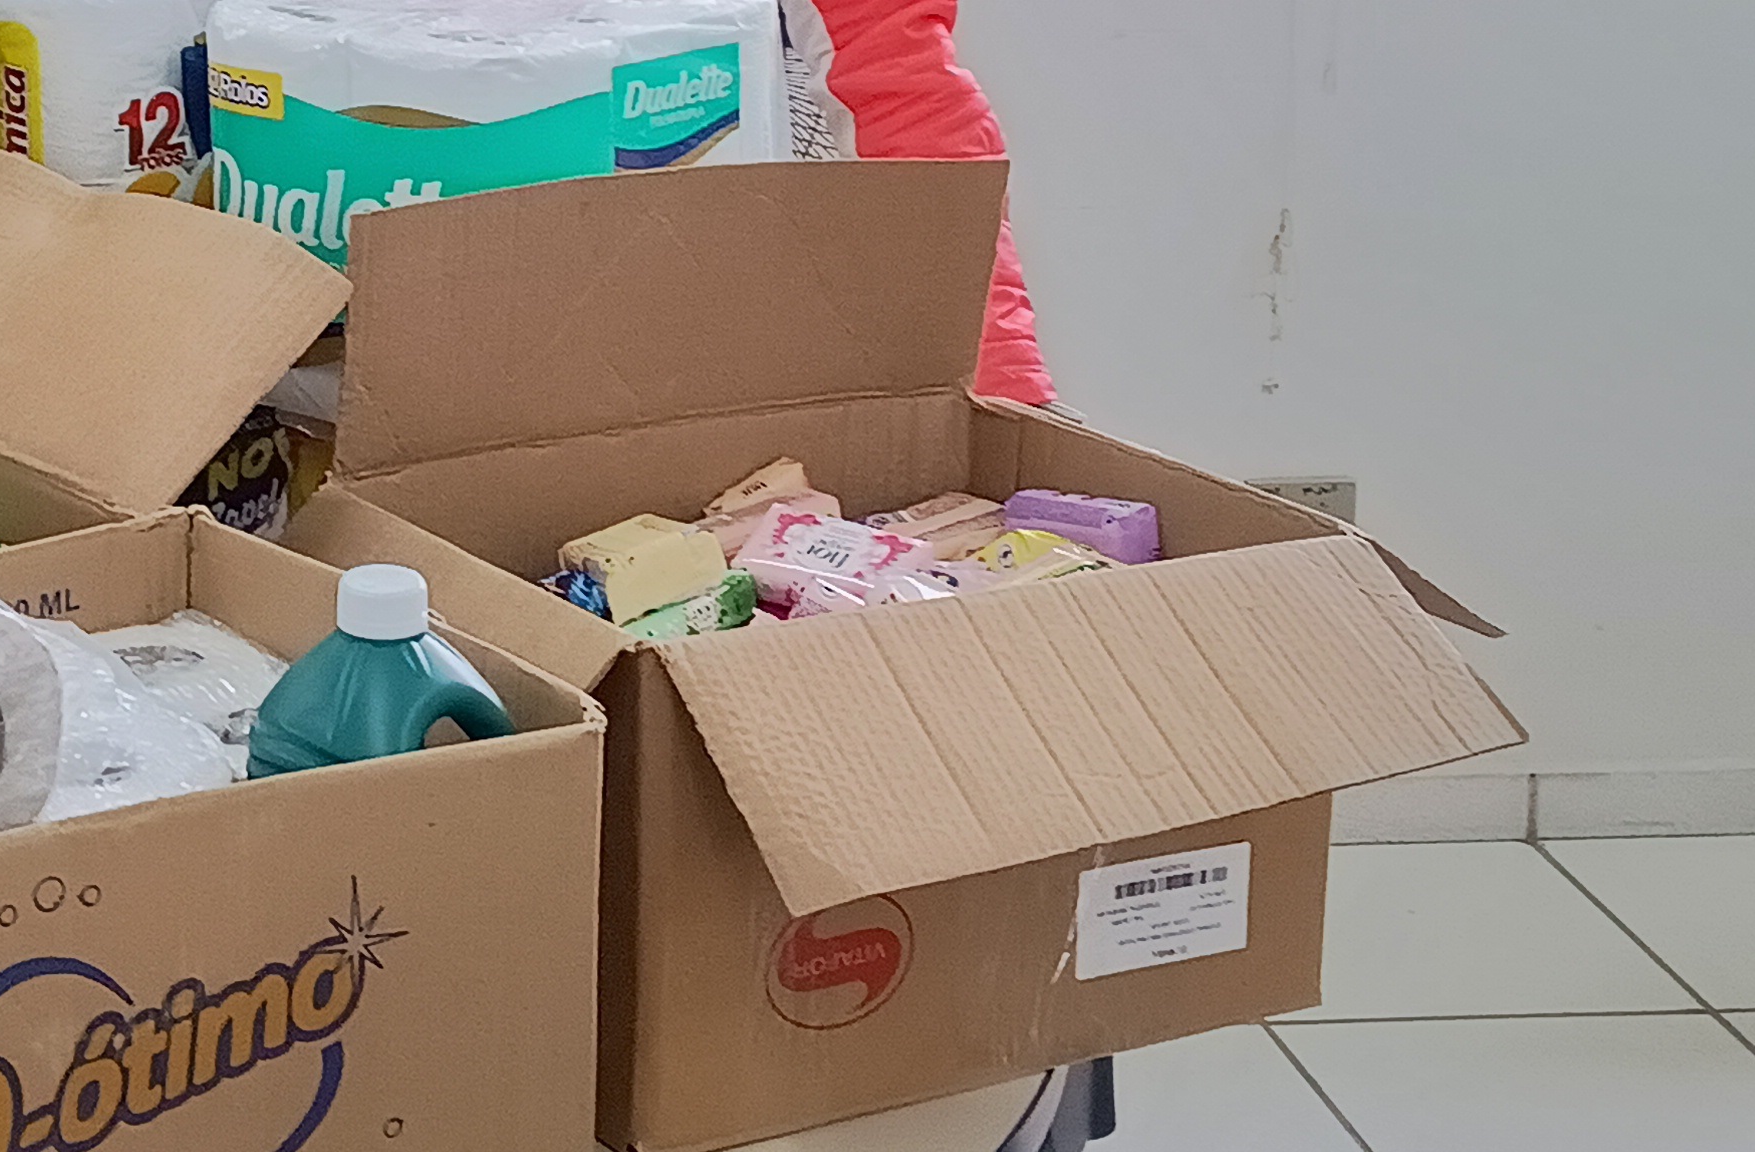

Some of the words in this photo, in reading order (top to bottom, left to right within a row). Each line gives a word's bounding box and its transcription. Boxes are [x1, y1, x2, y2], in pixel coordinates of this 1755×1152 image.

[622, 62, 734, 120] Dualette
[117, 90, 188, 169] 12
[37, 587, 81, 619] ML
